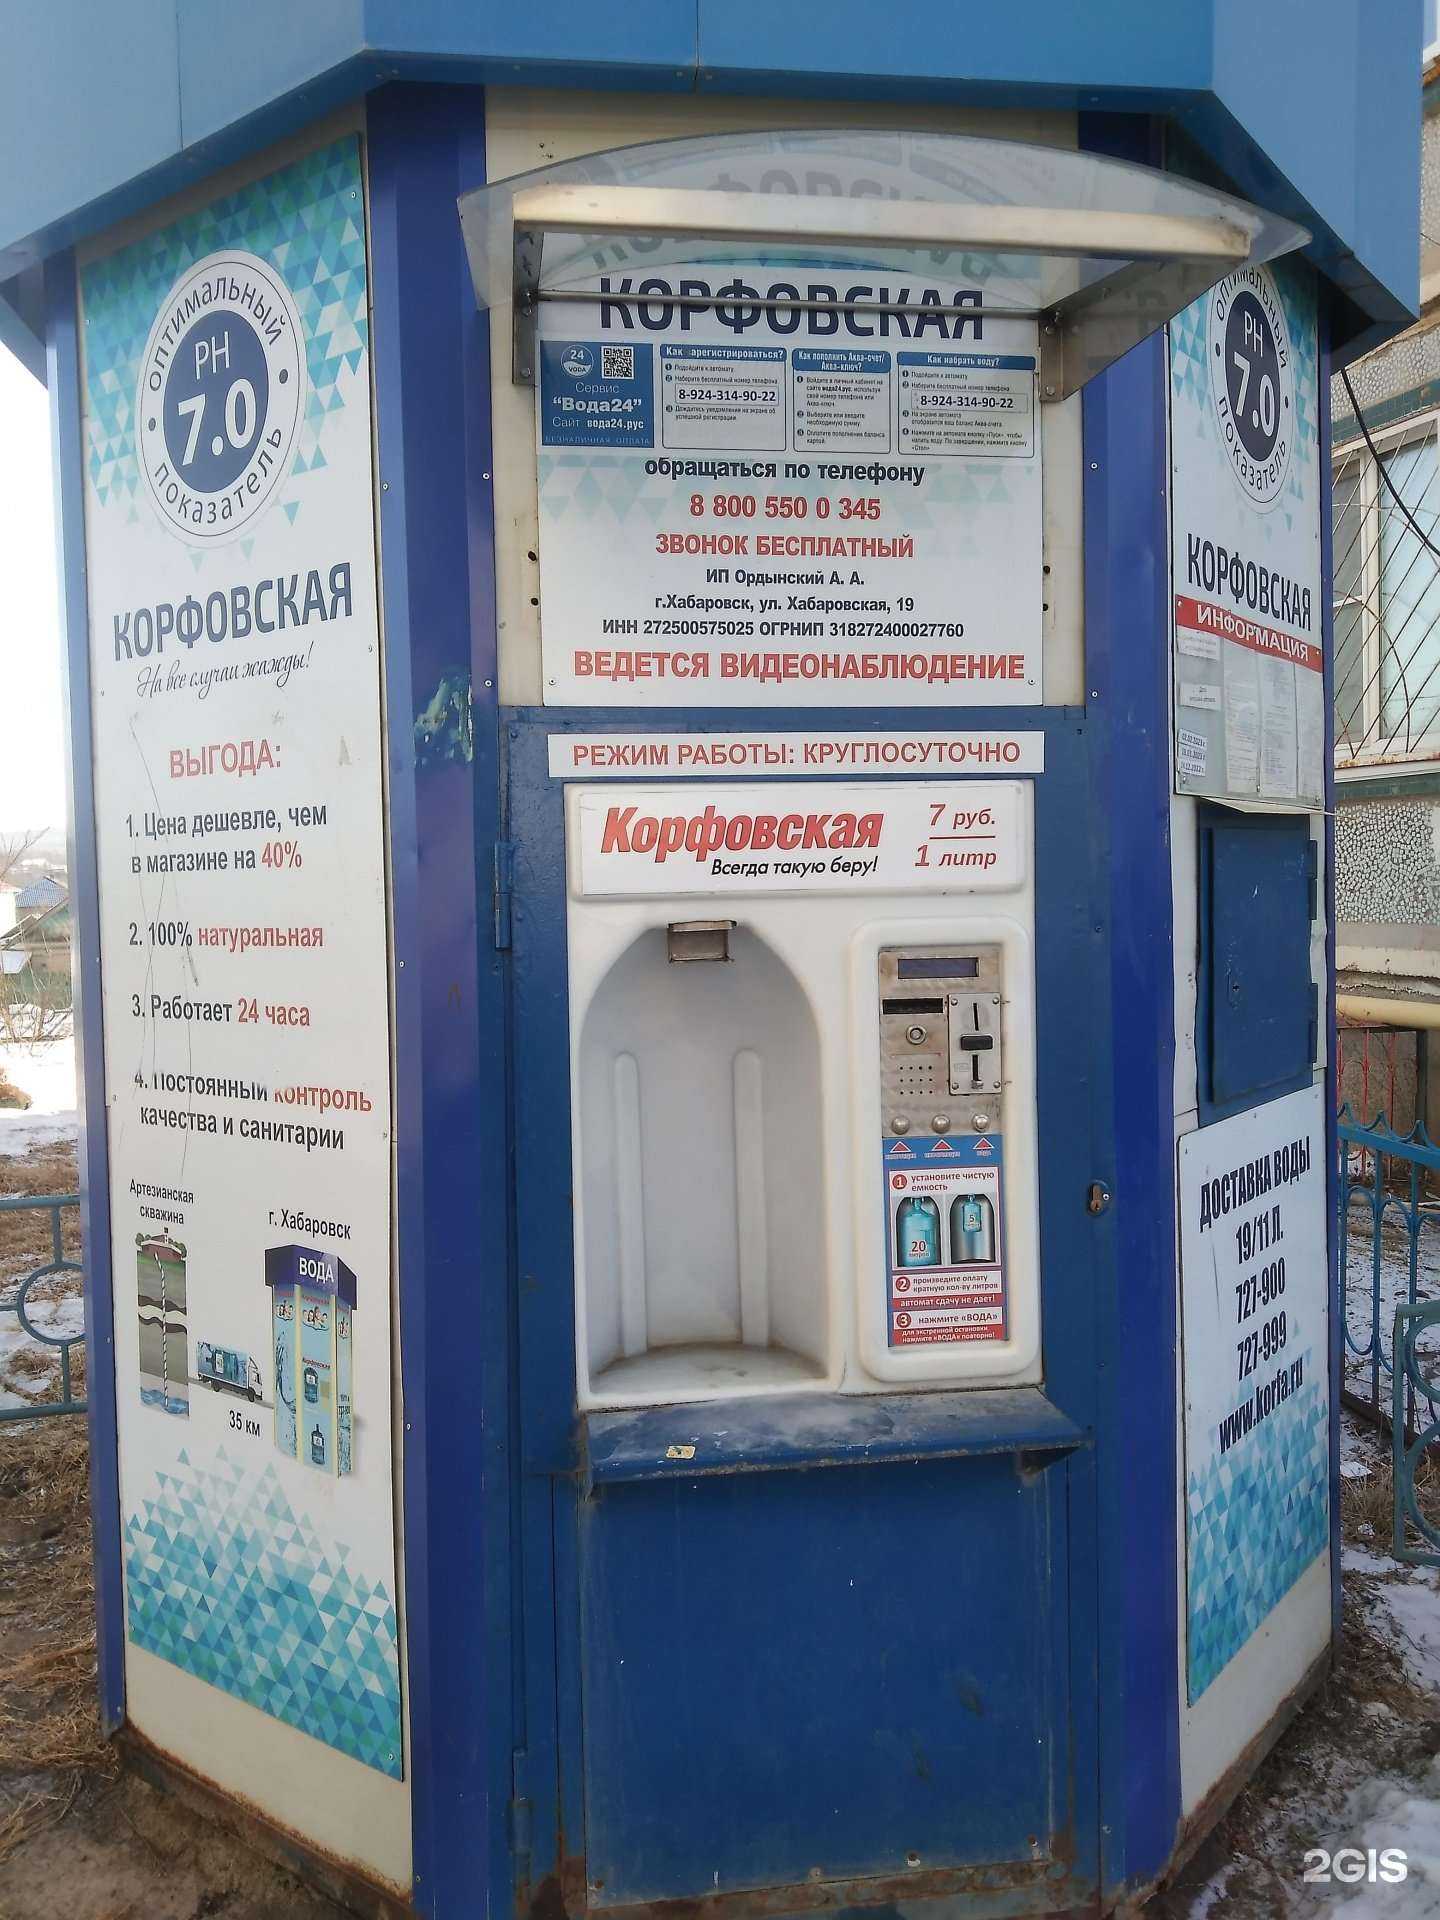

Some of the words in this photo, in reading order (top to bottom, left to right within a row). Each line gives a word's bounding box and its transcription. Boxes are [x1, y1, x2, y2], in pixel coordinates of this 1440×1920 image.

[600, 277, 983, 341] КОРФОВСКАЯ
[571, 350, 584, 359] 24
[666, 347, 683, 356] Как
[799, 351, 810, 360] Как
[813, 353, 847, 361] пополнить
[928, 355, 941, 364] Как
[944, 357, 974, 366] набрать
[978, 358, 999, 367] воду?
[576, 382, 619, 394] Сервис
[679, 389, 776, 401] 8-924-314-90-22
[920, 395, 1014, 408] 8-924-314-90-22
[1234, 351, 1274, 436] 7.0
[178, 378, 256, 466] 7.0
[553, 417, 579, 427] Сайт
[587, 419, 643, 430] вода24.рус
[645, 458, 776, 480] обращаться
[785, 464, 810, 479] по
[818, 462, 924, 486] телефону
[690, 494, 704, 516] 8
[713, 496, 756, 518] 800
[766, 496, 807, 518] 550
[816, 498, 830, 519] 0
[839, 498, 880, 520] 345
[656, 534, 748, 555] ЗВОНОК
[756, 534, 914, 558] БЕСПЛАТНЫЙ
[706, 569, 729, 583] ИП
[735, 569, 825, 587] Ордынский
[829, 571, 844, 585] А.
[850, 571, 864, 586] А.
[1187, 533, 1311, 632] КОРФОВСКАЯ
[113, 562, 352, 661] КОРФОВСКАЯ
[656, 595, 754, 612] г.Хабаровск,
[759, 598, 781, 613] ул.
[787, 597, 890, 613] Хабаровская,
[897, 597, 914, 611] 19
[603, 620, 638, 634] ИНН
[644, 620, 754, 636] 272500575025
[759, 622, 824, 636] ОГРНИП
[829, 623, 964, 637] 318272400027760
[1197, 604, 1308, 662] ИНФОРМАЦИЯ
[137, 664, 162, 698] На
[166, 660, 186, 691] все
[242, 641, 314, 687] жажды!
[574, 651, 709, 682] ВЕДЕТСЯ
[721, 653, 1025, 683] ВИДЕОНАБЛЮДЕНИЕ
[170, 739, 281, 778] ВЫГОДА:
[573, 744, 669, 766] РЕЖИМ
[678, 742, 794, 766] РАБОТЫ:
[804, 741, 1020, 765] КРУГЛОСУТОЧНО
[127, 815, 139, 837] 1.
[145, 811, 187, 840] Цена
[192, 809, 282, 838] дешевле,
[289, 805, 327, 826] чем
[930, 803, 946, 826] 7
[953, 809, 995, 831] руб.
[601, 805, 884, 863] Корфовская
[132, 856, 141, 874] в
[147, 850, 228, 873] магазине
[234, 850, 255, 870] на
[262, 840, 301, 869] 40%
[711, 858, 769, 877] Всегда
[773, 859, 826, 878] такую
[830, 856, 878, 878] беру!
[914, 844, 930, 867] 1
[938, 850, 996, 870] литр
[129, 922, 142, 946] 2.
[149, 921, 192, 947] 100%
[198, 927, 323, 952] натуральная
[132, 994, 145, 1017] 3.
[151, 994, 232, 1022] Работает
[238, 998, 259, 1023] 24
[265, 1005, 310, 1026] часа
[274, 1086, 372, 1113] контроль
[141, 1107, 217, 1133] качества
[223, 1116, 233, 1135] и
[239, 1118, 344, 1152] санитарии
[130, 1179, 194, 1204] Артезианская
[911, 1174, 960, 1182] установите
[1200, 1155, 1271, 1233] ДОСТАВКА
[1274, 1136, 1310, 1185] ВОДЫ
[140, 1204, 184, 1224] скважина
[269, 1210, 278, 1226] г.
[280, 1209, 350, 1240] Хабаровск
[912, 1241, 926, 1252] 20
[1236, 1211, 1269, 1264] 19/11
[299, 1257, 334, 1284] ВОДА
[901, 1299, 933, 1307] автомат
[973, 1295, 995, 1303] дает!
[1236, 1257, 1286, 1324] 727-900
[919, 1316, 959, 1324] нажмите
[1237, 1311, 1287, 1381] 727-999
[1219, 1356, 1303, 1455] www.korfa.ru
[229, 1410, 242, 1430] 35
[246, 1420, 260, 1436] км
